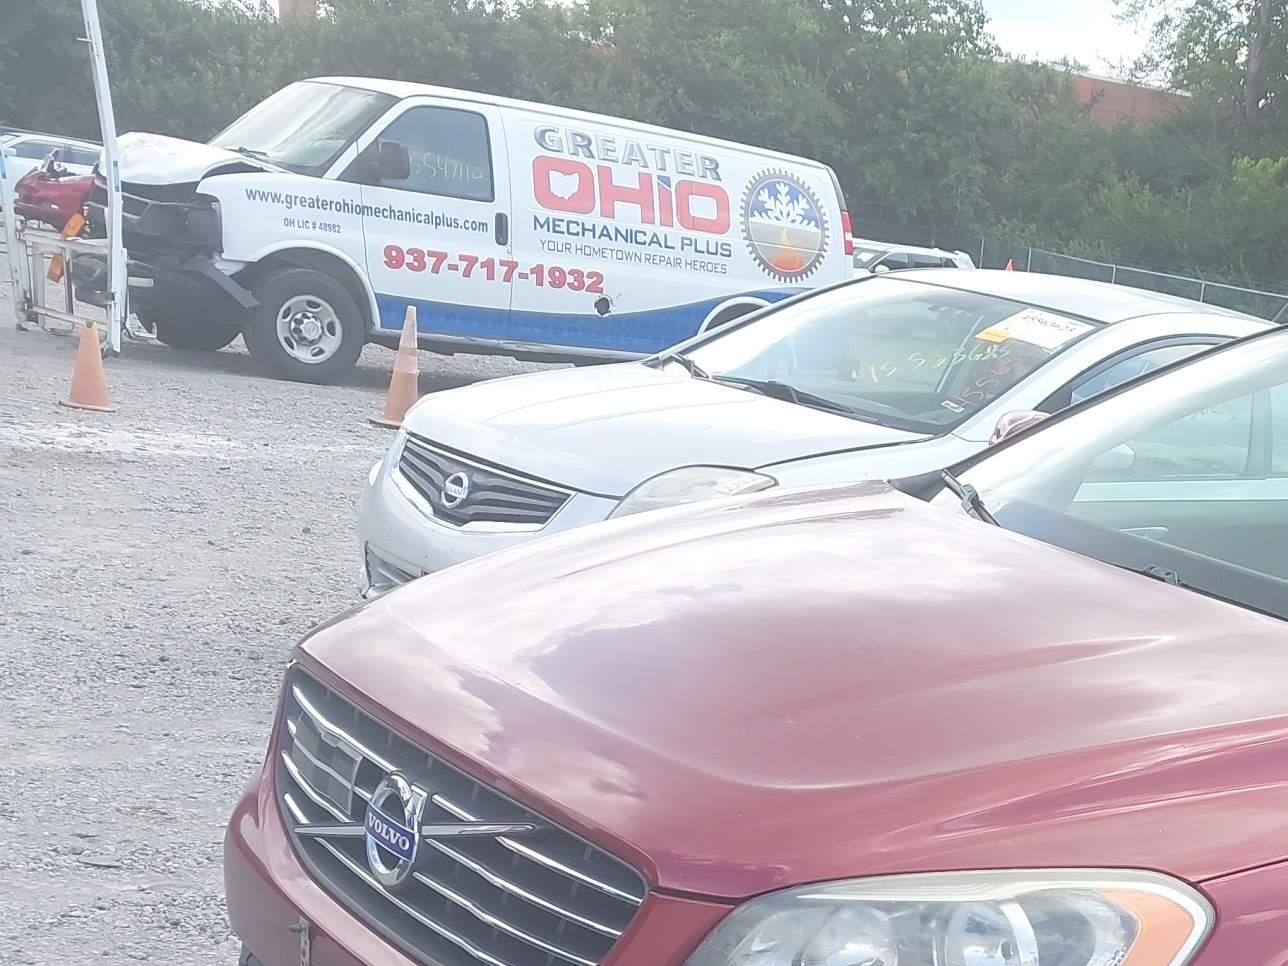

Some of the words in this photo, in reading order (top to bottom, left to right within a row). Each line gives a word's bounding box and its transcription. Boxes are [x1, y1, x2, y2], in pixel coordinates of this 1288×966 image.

[533, 124, 722, 182] GREATER
[245, 187, 489, 233] www.greaterohiomechanicalplus.com
[283, 217, 295, 229] OH
[297, 219, 310, 230] LIC
[533, 215, 676, 250] MECHANICAL
[680, 236, 732, 258] PLUS
[539, 239, 572, 254] YOUR
[575, 243, 643, 264] HOMETOWN
[644, 253, 682, 268] REPAIR
[685, 260, 728, 275] HEROES
[383, 244, 604, 294] 937-717-1932
[368, 811, 410, 851] VOLVO
